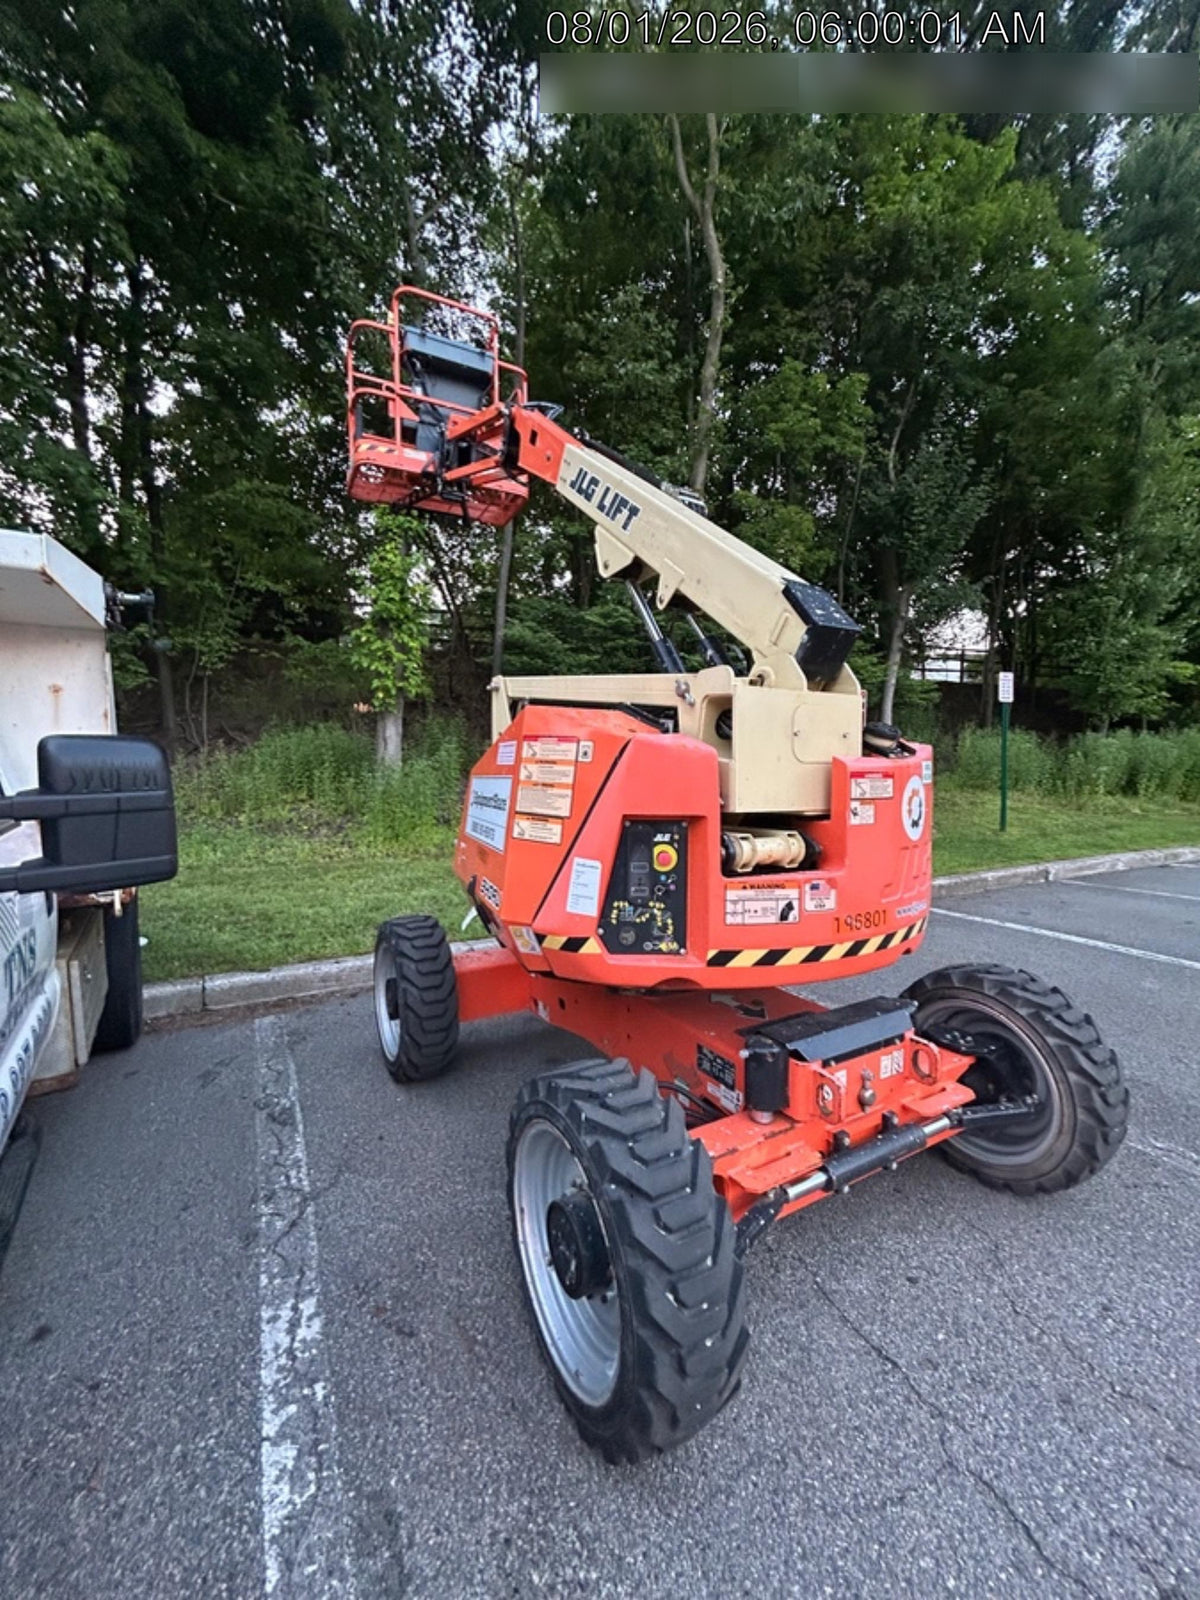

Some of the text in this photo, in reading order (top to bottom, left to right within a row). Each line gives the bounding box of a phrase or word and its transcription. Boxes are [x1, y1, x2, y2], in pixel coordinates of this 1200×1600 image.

[568, 466, 641, 531] JLG LIFT
[653, 833, 672, 842] JLG
[833, 908, 888, 935] 196801
